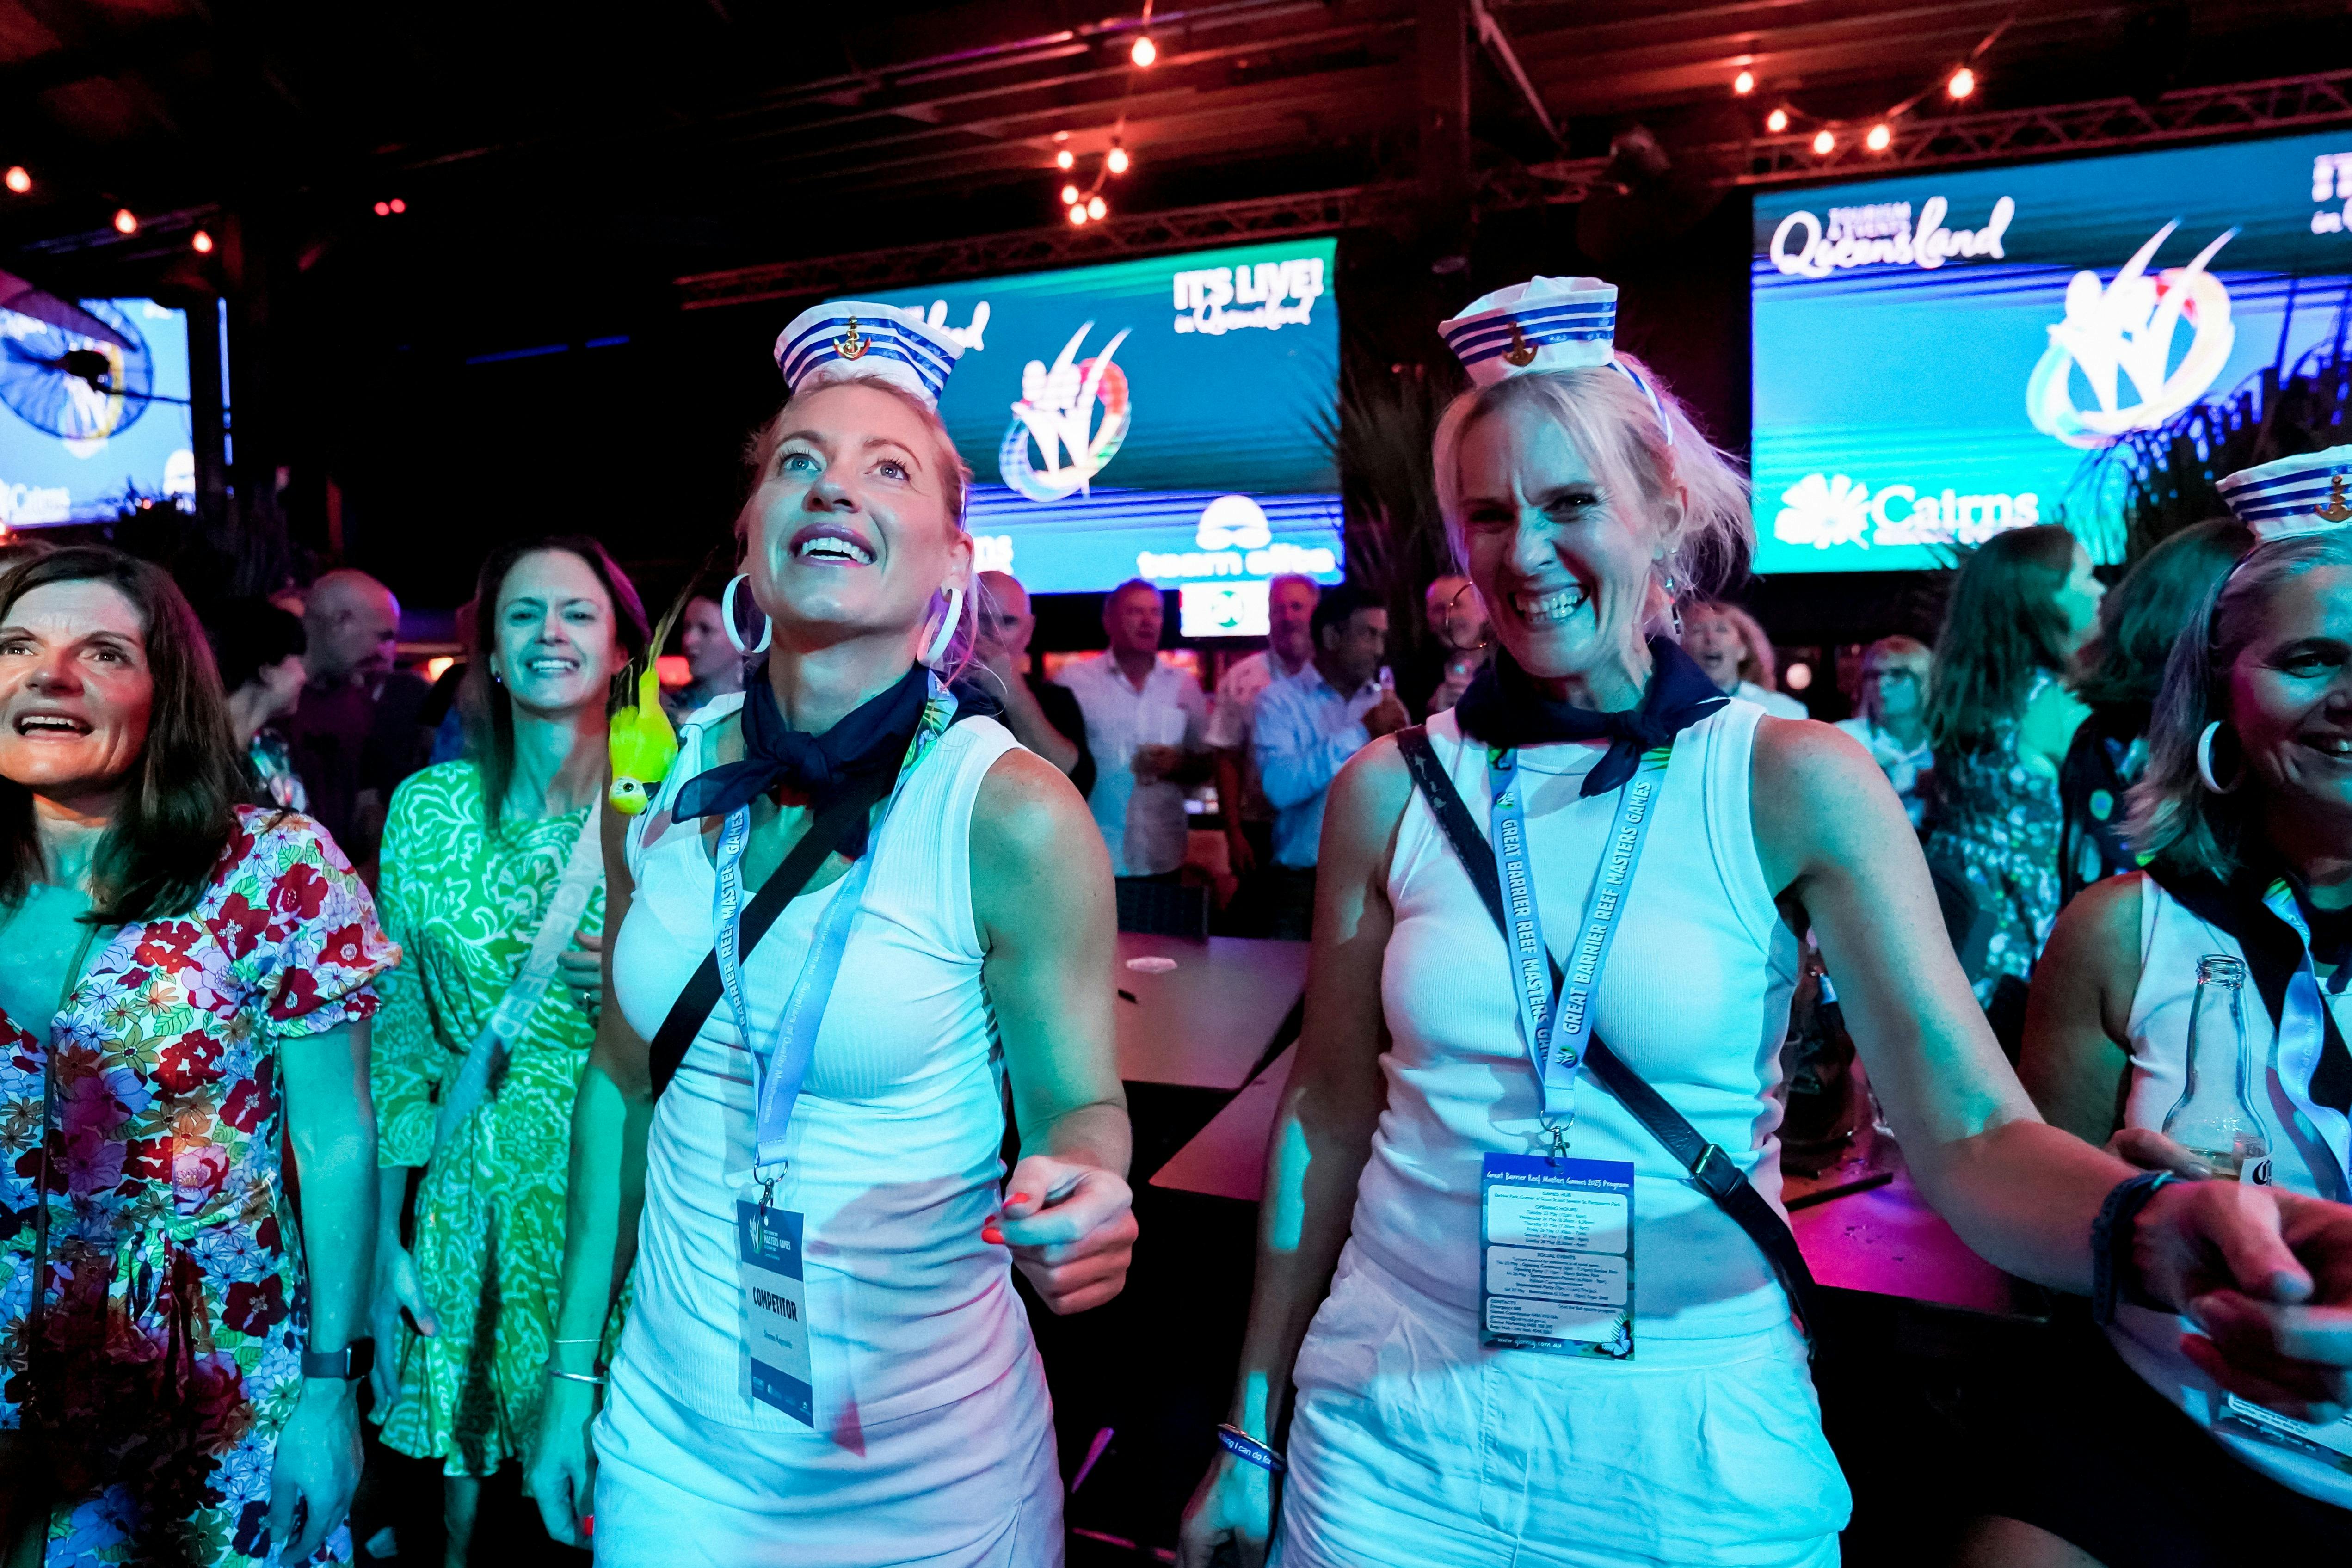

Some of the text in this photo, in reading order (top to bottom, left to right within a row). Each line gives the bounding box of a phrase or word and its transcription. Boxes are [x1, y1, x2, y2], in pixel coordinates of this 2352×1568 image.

[1770, 196, 2014, 277] Queensland
[1871, 485, 2039, 527] Cairns
[1501, 818, 1521, 858] GREAT
[1506, 861, 1528, 918] BARRIER
[1563, 781, 1653, 1035] GREAT BARRIER REEF MASTERS GAMES
[721, 810, 746, 1026] BARRIER REEF MASTER GAMES
[1516, 920, 1538, 954] REEF
[1522, 958, 1549, 1024] MASTERS
[777, 1036, 792, 1069] Quality
[1505, 1172, 1526, 1181] Barrier
[1528, 1174, 1540, 1184] Reef
[753, 1286, 798, 1322] COMPETITOR
[1238, 1445, 1251, 1456] can
[1252, 1451, 1262, 1460] do
